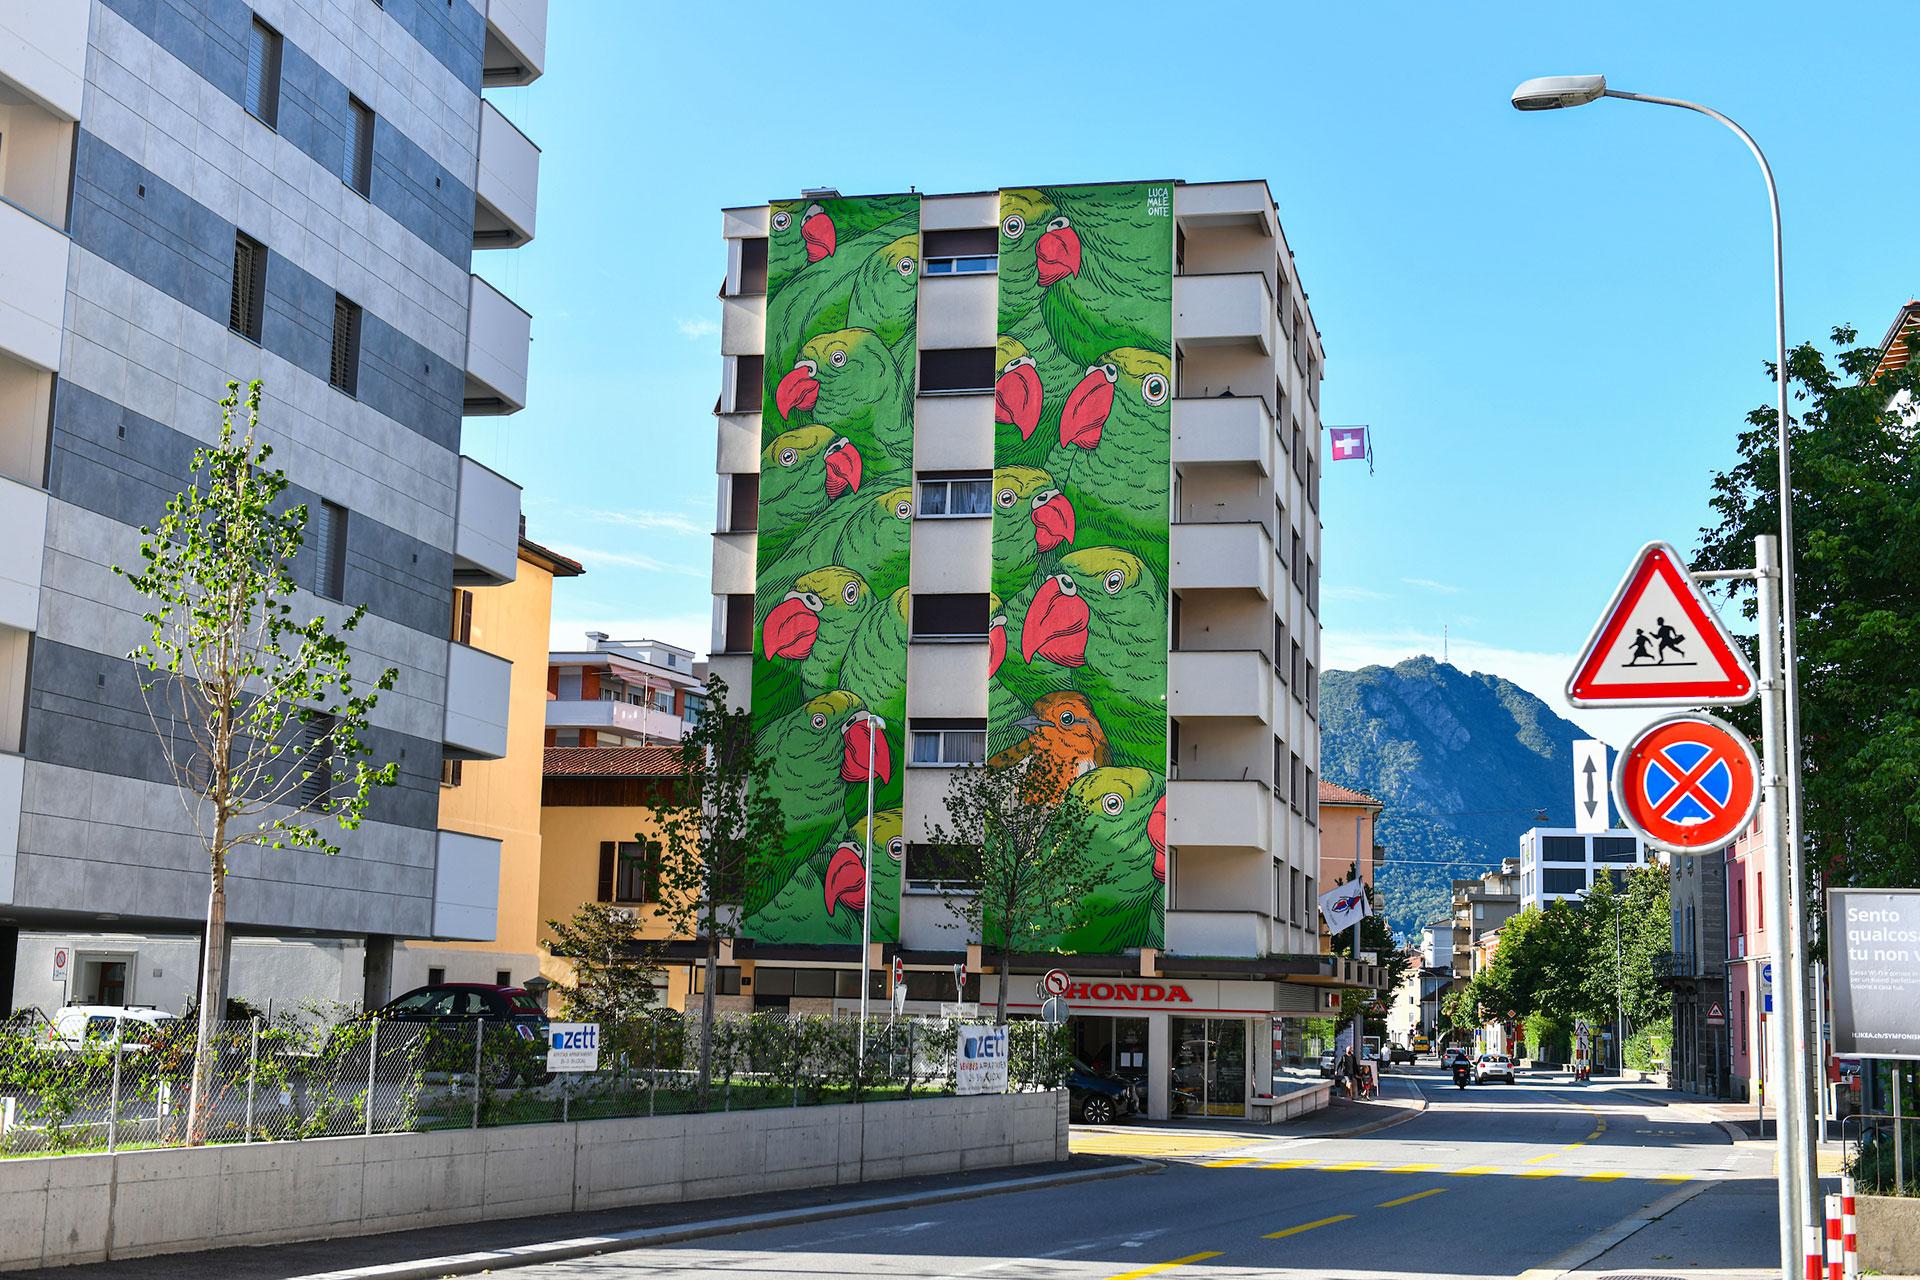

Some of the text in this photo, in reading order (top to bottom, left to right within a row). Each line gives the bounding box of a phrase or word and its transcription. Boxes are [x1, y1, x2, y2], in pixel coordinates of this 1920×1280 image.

[1148, 188, 1168, 197] LUCA
[1147, 197, 1169, 207] MALE
[1148, 207, 1169, 216] ONTE
[1848, 908, 1900, 922] Sento
[1849, 947, 1868, 961] tu
[1874, 949, 1909, 961] non
[1064, 983, 1193, 1003] HONDA
[564, 1025, 596, 1049] zett
